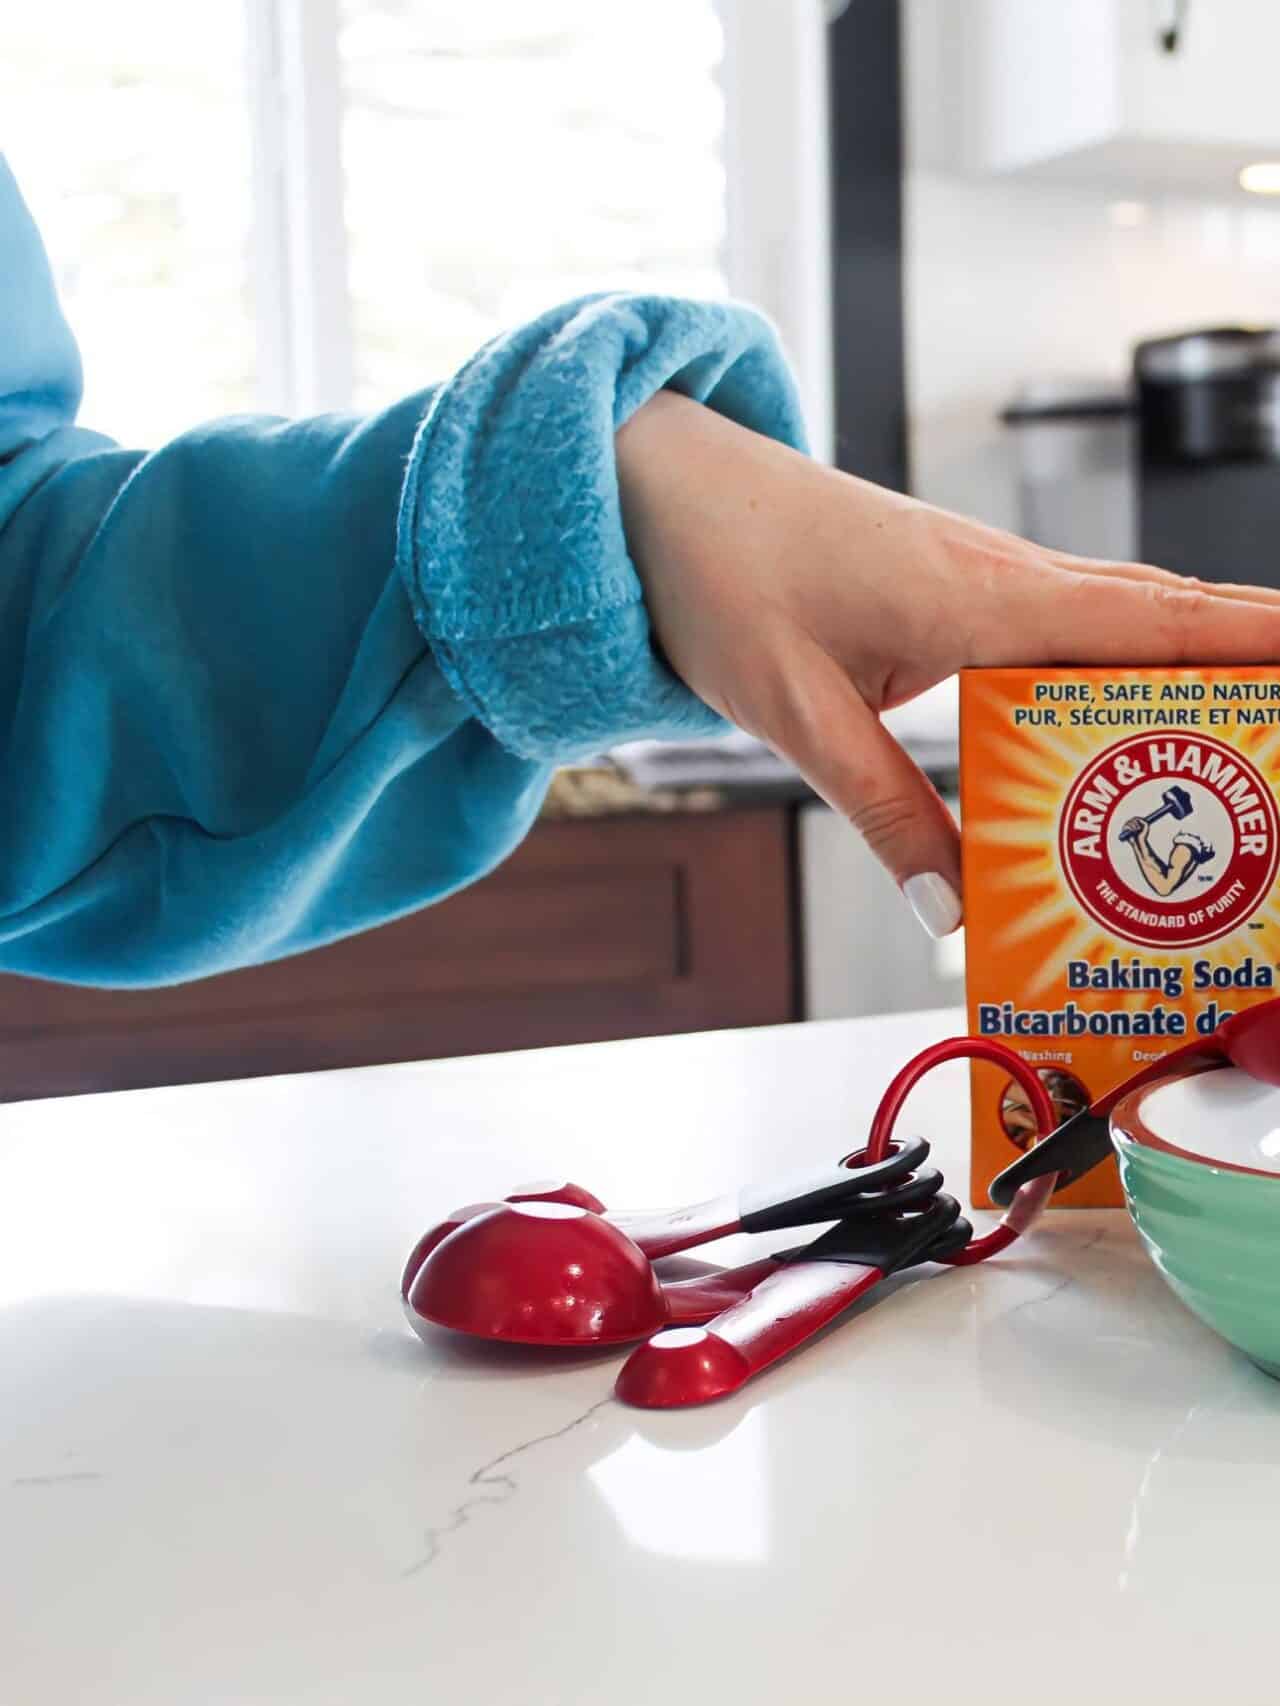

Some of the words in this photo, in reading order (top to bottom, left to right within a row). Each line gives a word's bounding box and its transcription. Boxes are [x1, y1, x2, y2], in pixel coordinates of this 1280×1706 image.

[1035, 684, 1096, 703] PURE,
[1103, 684, 1153, 701] SAFE
[1160, 684, 1206, 701] AND
[1014, 709, 1063, 728] PUR,
[1069, 706, 1201, 726] SÉCURITAIRE
[1209, 709, 1230, 725] ET
[1073, 775, 1120, 859] ARM
[1113, 754, 1146, 786] &
[1148, 742, 1268, 856] HAMMER
[1095, 879, 1119, 905] THE
[1116, 901, 1185, 928] STANDARD
[1189, 911, 1205, 925] OF
[1206, 879, 1247, 918] PURITY
[1068, 960, 1183, 998] Baking
[1193, 958, 1273, 989] Soda
[979, 1003, 1186, 1036] Bicarbonate
